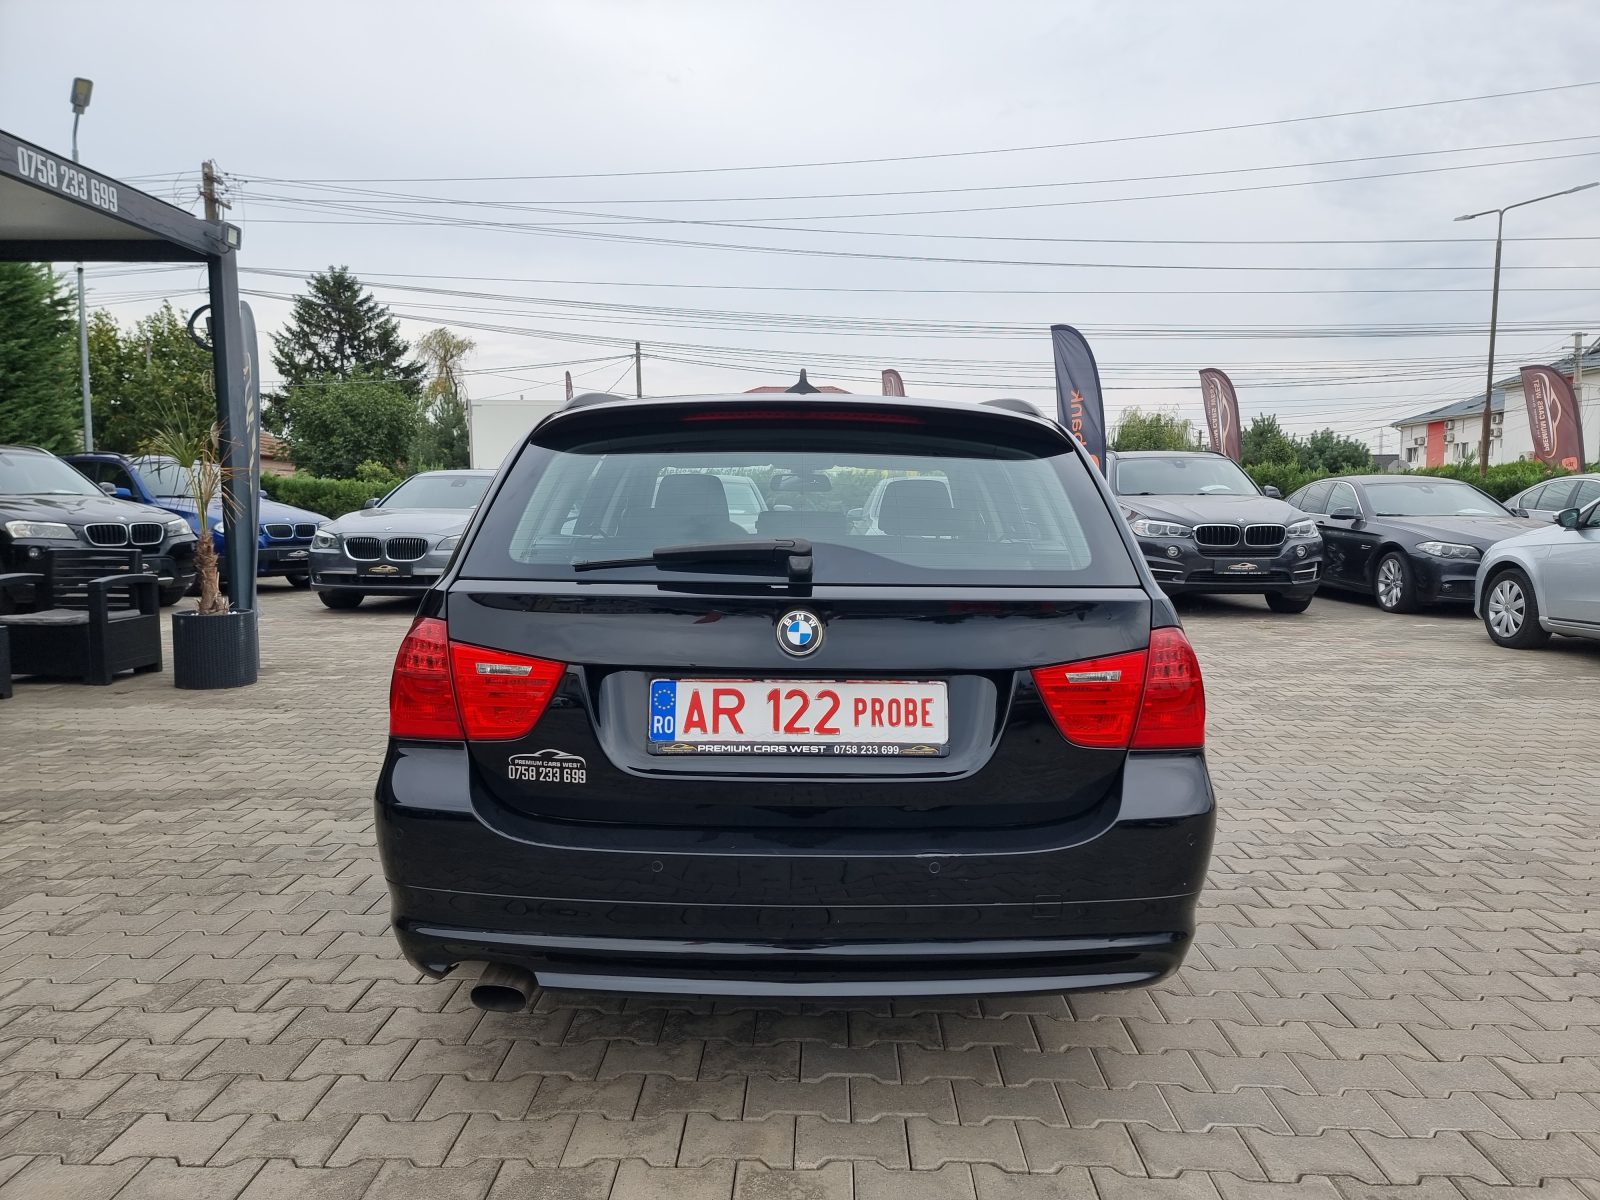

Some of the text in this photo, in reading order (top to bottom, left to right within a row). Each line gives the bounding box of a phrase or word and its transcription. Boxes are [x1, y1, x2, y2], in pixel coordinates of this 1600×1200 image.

[17, 146, 118, 213] 0758 233 699
[783, 614, 817, 627] BMW
[683, 687, 935, 735] AR 122 PROBE
[653, 715, 674, 734] RO
[697, 744, 900, 755] PREMIUM CARS WEST 0758 233 699
[508, 765, 586, 783] 0758 233 699
